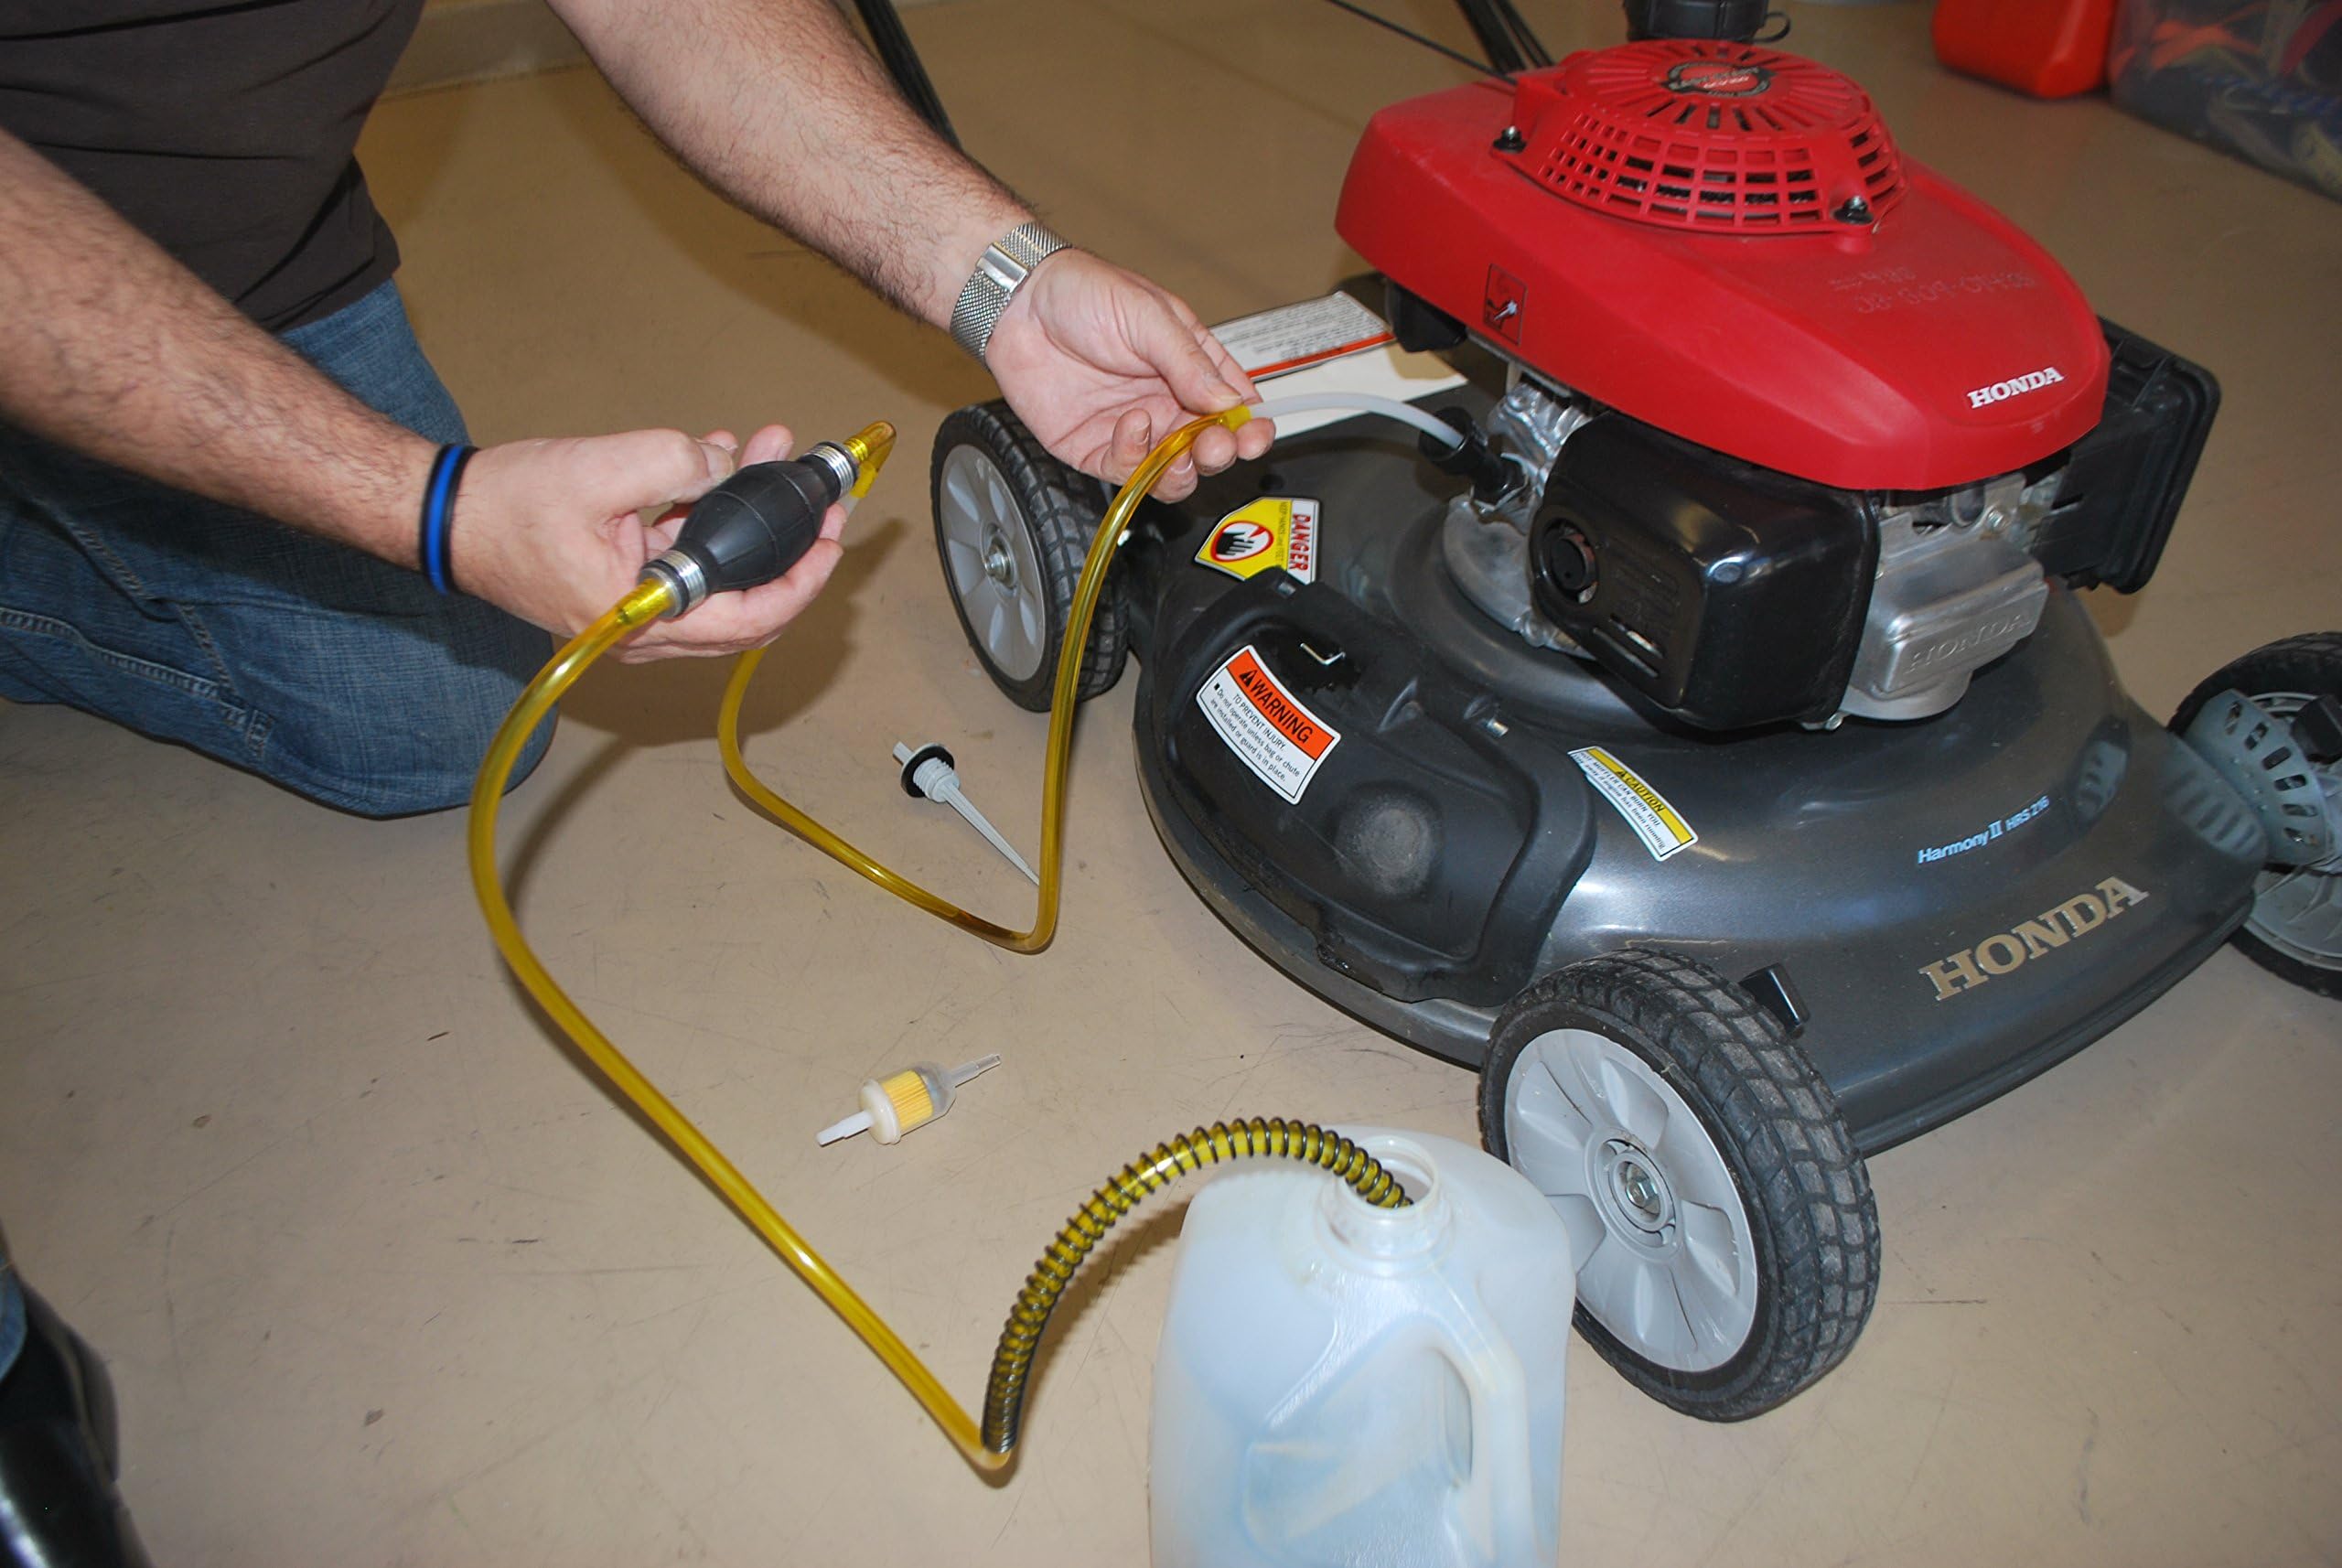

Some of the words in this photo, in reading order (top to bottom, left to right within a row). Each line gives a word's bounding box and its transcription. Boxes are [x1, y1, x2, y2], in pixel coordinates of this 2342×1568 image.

[1967, 367, 2064, 409] HONDA
[1289, 514, 1311, 571] DANGER
[1904, 614, 2031, 674] HONDA
[1218, 689, 1224, 699] Do
[1223, 699, 1231, 709] not
[1230, 708, 1248, 728] operate
[1247, 728, 1264, 746] unless
[1263, 743, 1276, 758] bag
[1283, 761, 1300, 777] chute
[1218, 708, 1237, 732] installed
[1241, 737, 1257, 754] guard
[1256, 751, 1262, 759] is
[1262, 757, 1269, 766] in
[1233, 693, 1241, 704] TO
[1240, 703, 1265, 730] PREVENT
[1251, 679, 1313, 744] WARNING
[1593, 762, 1620, 784] MUFFLER
[1626, 774, 1665, 811] CAUTION
[1918, 830, 1990, 864] Harmony
[2005, 808, 2031, 832] HRS
[1918, 875, 2150, 1001] HONDA
